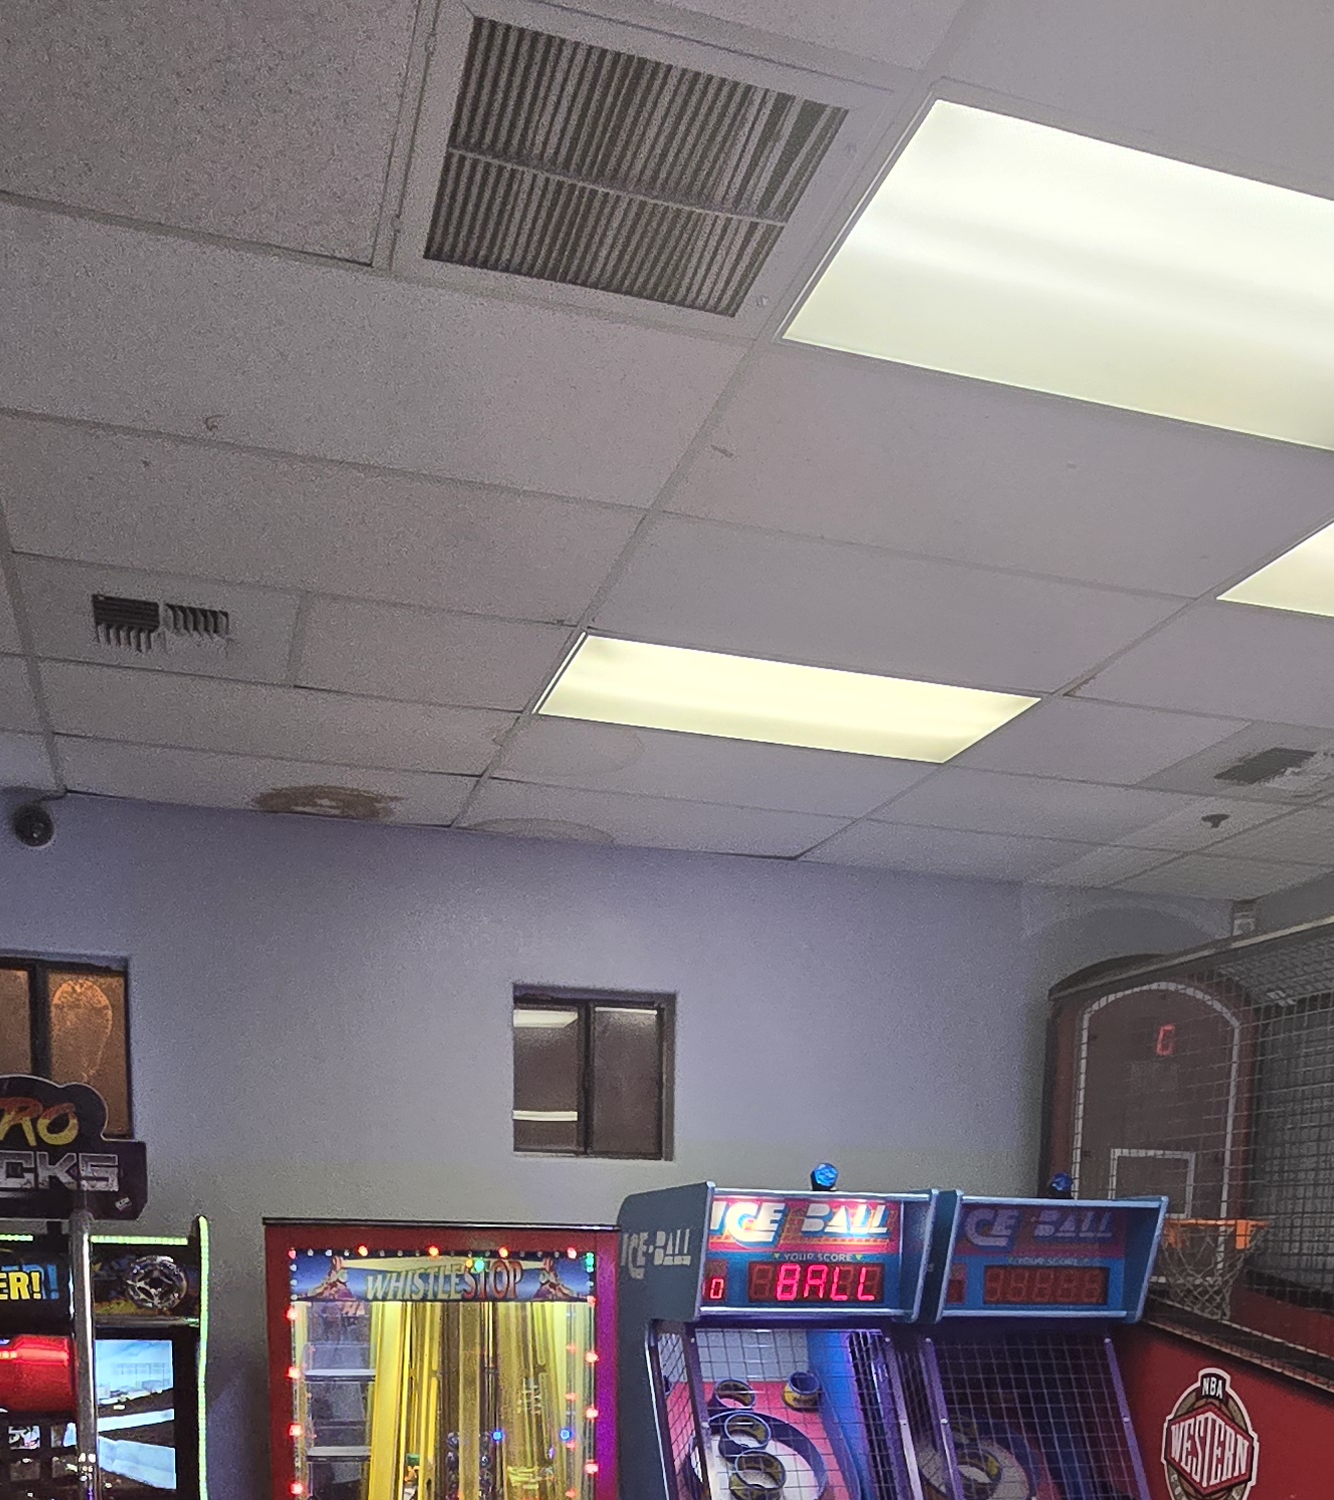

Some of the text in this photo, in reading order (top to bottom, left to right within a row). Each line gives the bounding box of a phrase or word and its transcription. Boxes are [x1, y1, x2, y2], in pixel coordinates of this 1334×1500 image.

[710, 1200, 888, 1242] ICE BALL
[967, 1208, 1019, 1247] CE
[784, 1253, 853, 1262] YOUR SCORE
[1201, 1377, 1224, 1399] NBA
[1170, 1411, 1250, 1488] WESTERN
